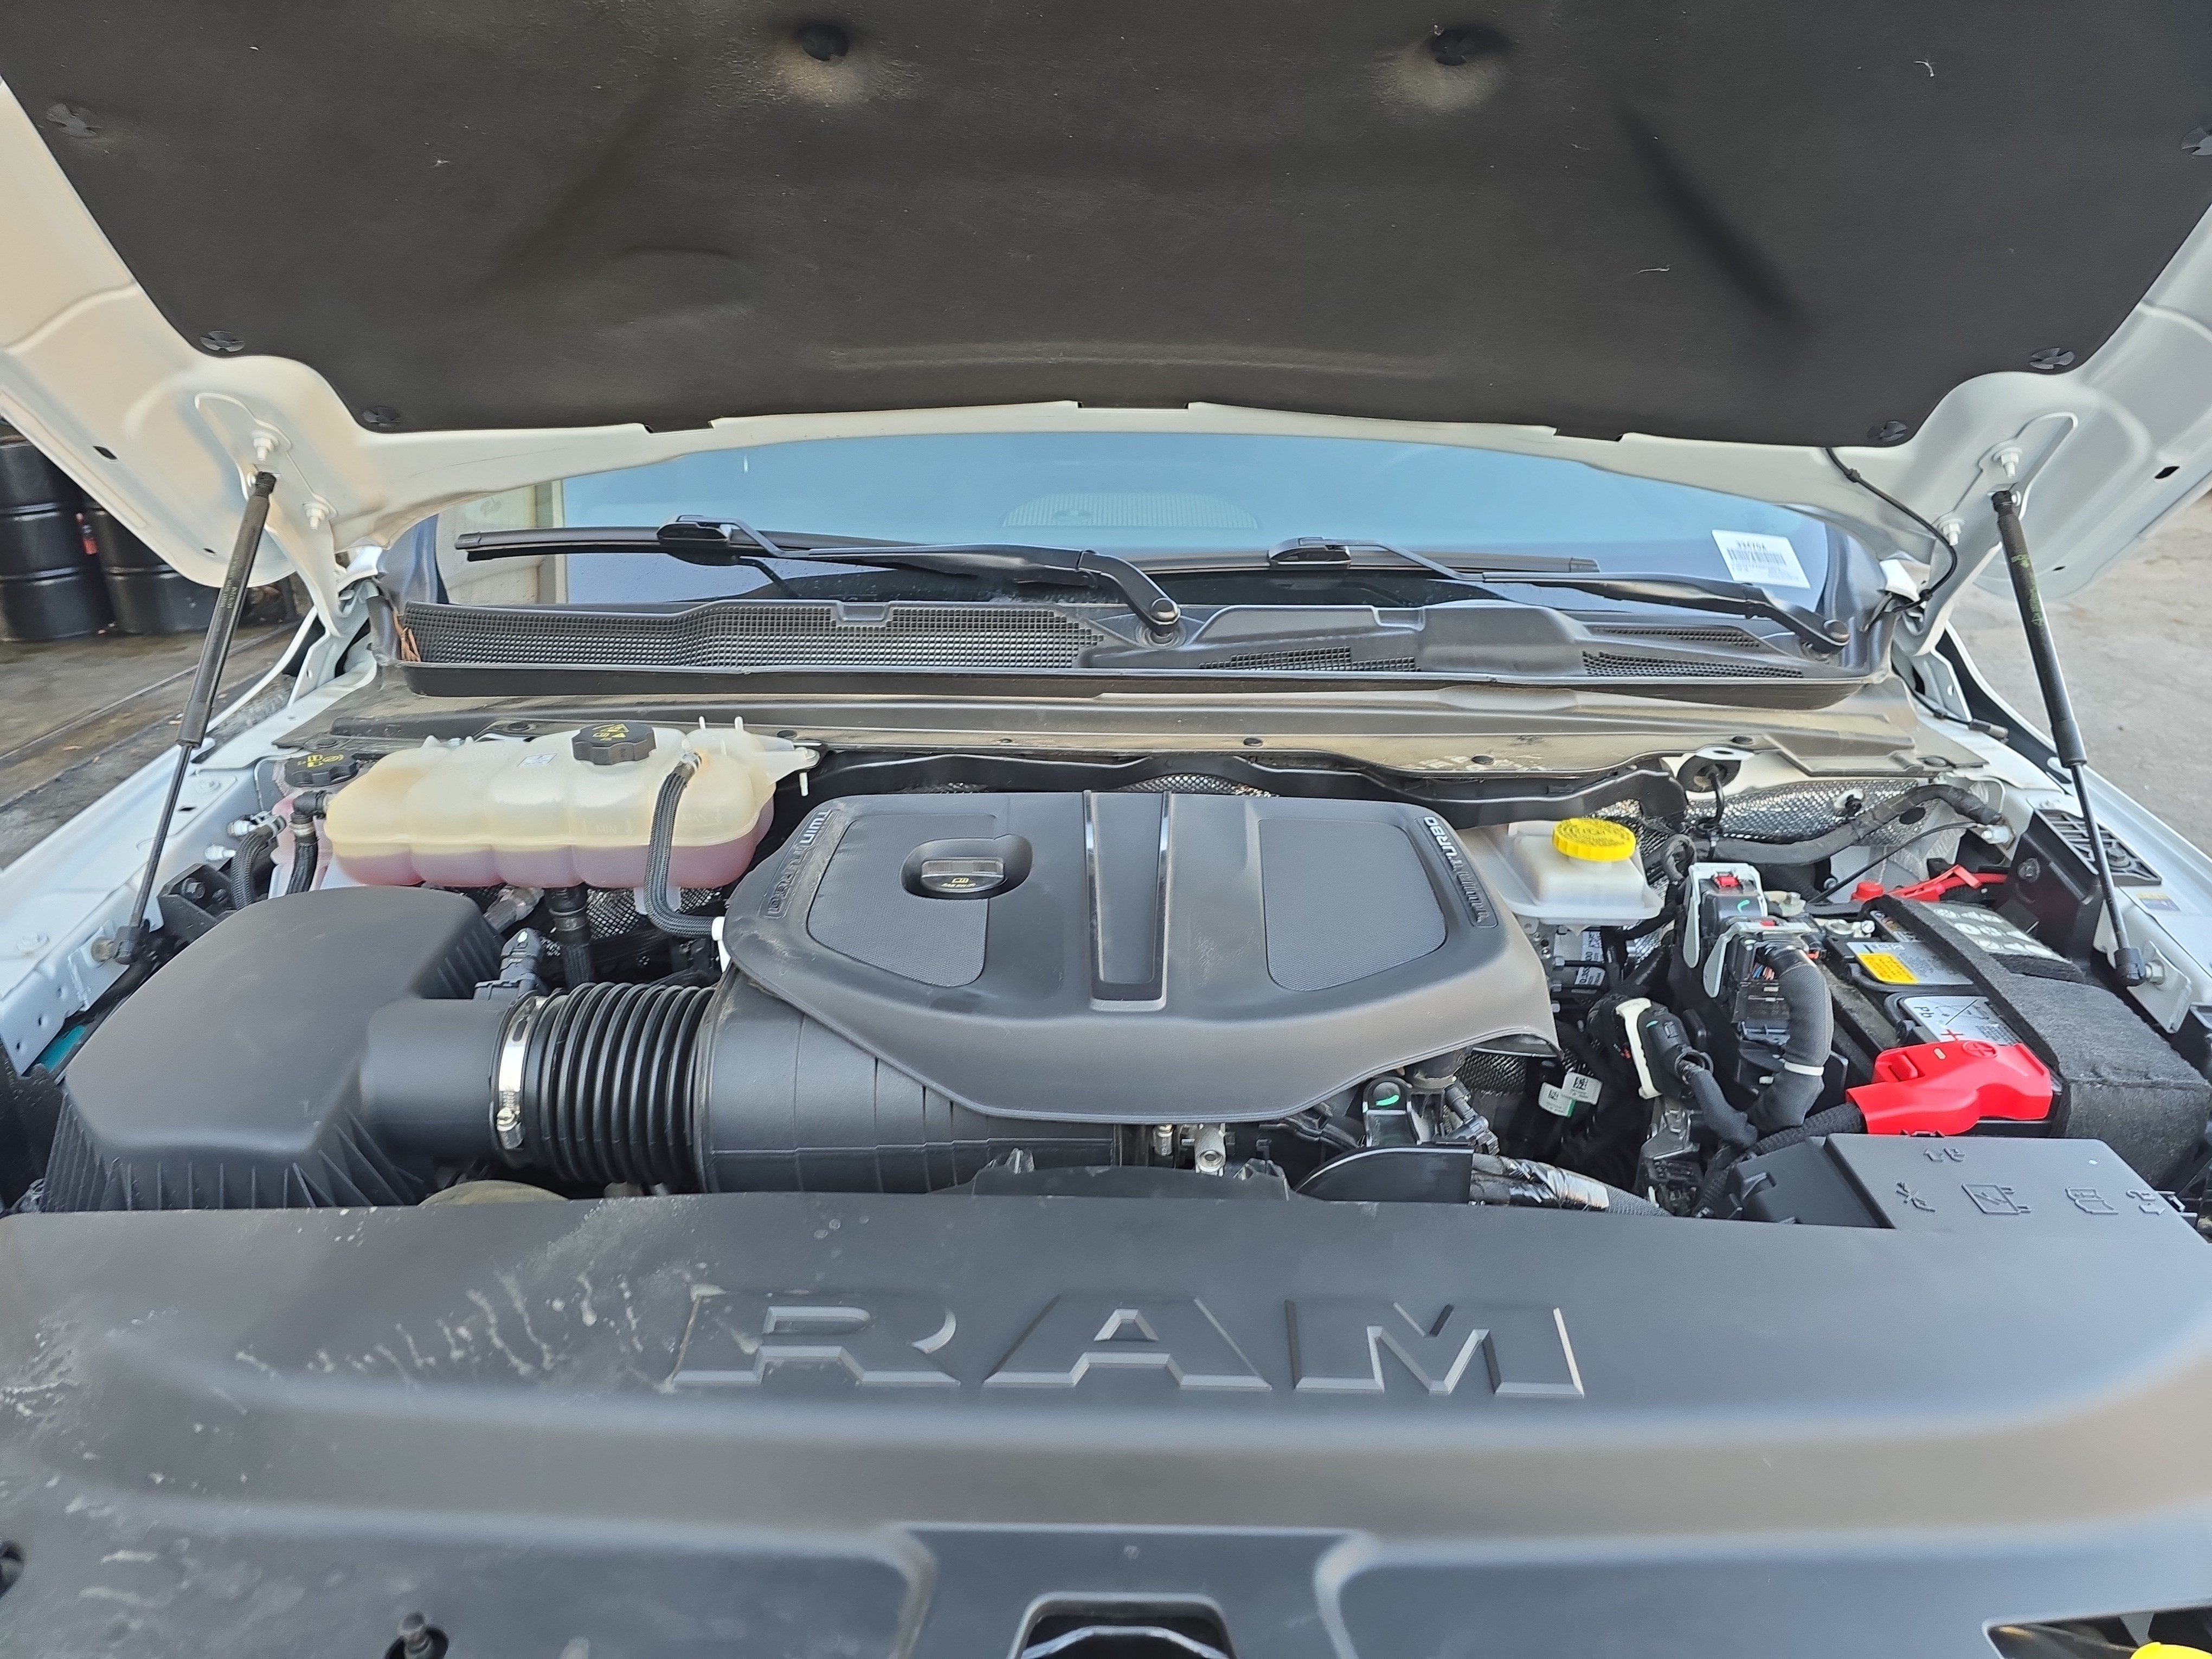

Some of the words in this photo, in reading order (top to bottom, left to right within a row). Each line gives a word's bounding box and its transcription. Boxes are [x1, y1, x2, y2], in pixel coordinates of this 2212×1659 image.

[799, 809, 833, 844] TWIN
[1424, 816, 1463, 871] TURBO
[768, 847, 810, 914] TURBO
[1914, 1006, 1933, 1018] Pb
[667, 1294, 1585, 1398] RAM
